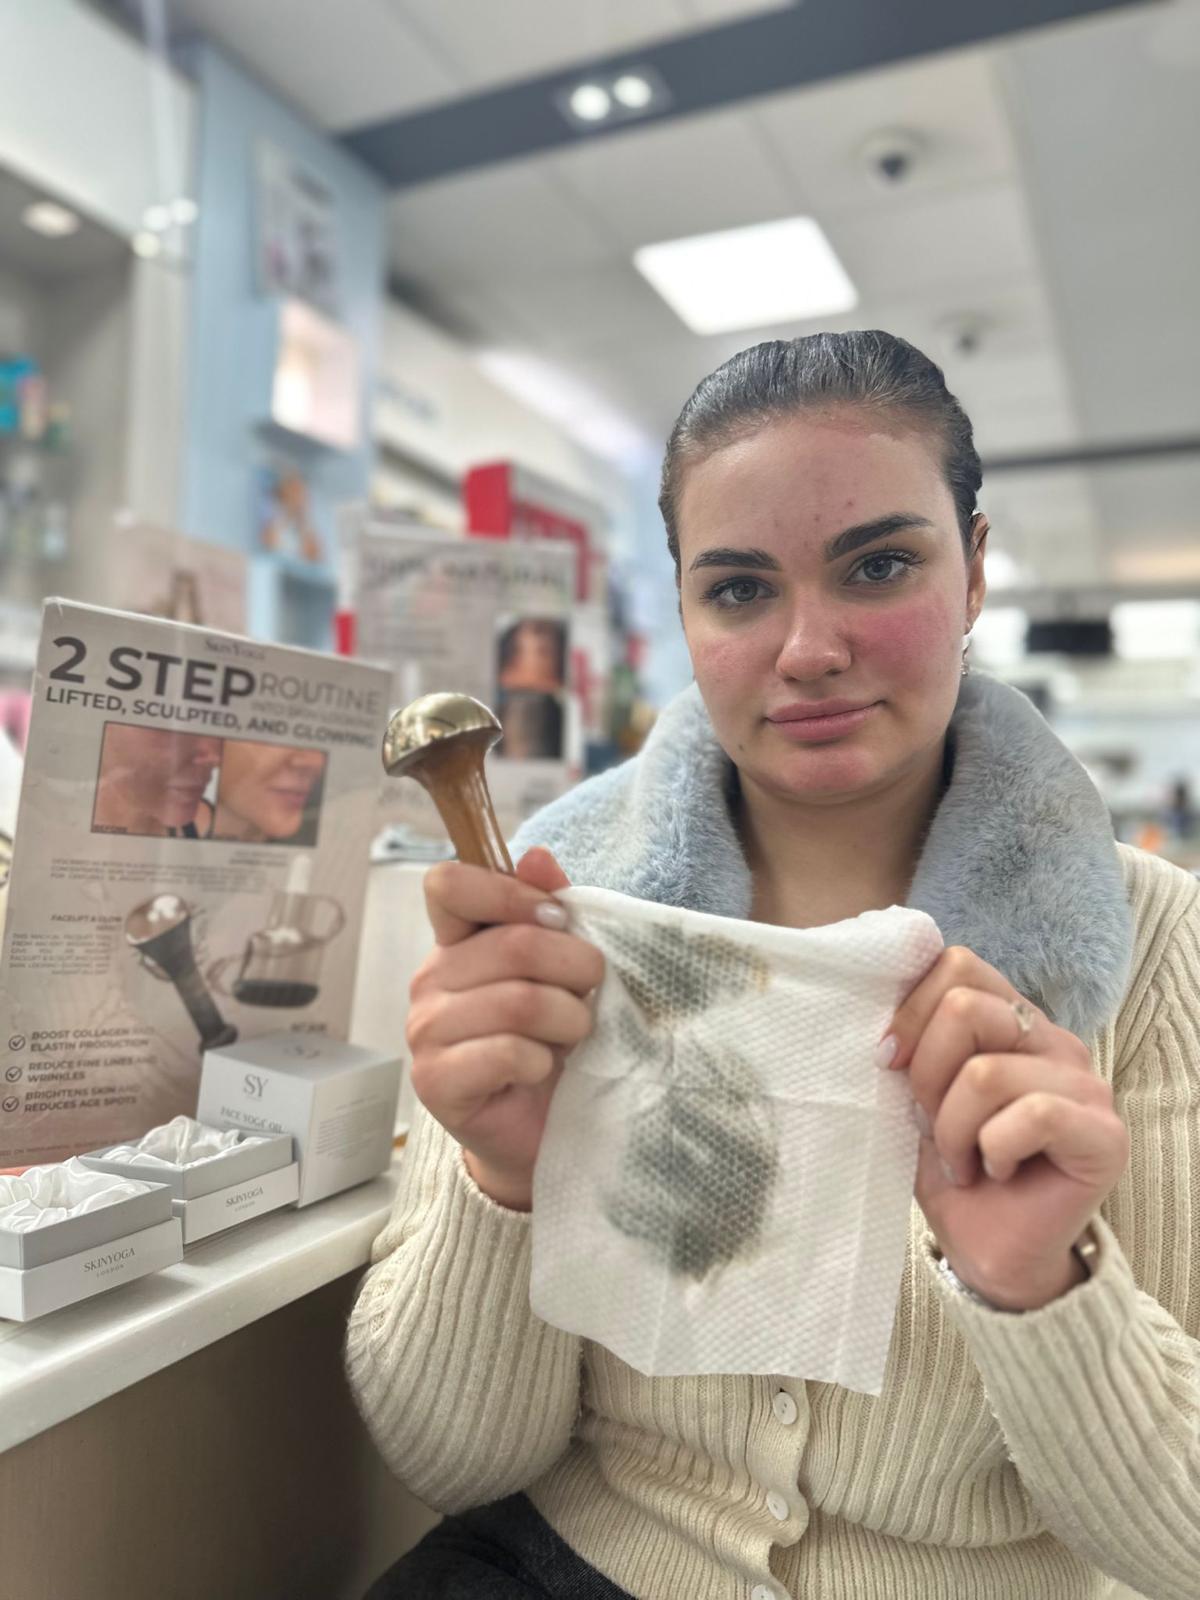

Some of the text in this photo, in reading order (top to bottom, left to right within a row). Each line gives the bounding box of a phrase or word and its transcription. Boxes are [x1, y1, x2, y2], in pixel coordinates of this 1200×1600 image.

[50, 636, 382, 715] 2 STEP ROUTINE
[46, 686, 376, 750] LIFTED, SCULPTED, AND GLOWING
[32, 1030, 70, 1041] BOOST
[73, 1028, 130, 1039] COLLAGEN
[31, 1039, 148, 1052] ELASTIN PRODUCTION
[29, 1060, 74, 1071] REDUCE
[77, 1059, 100, 1069] FINE
[104, 1057, 133, 1067] LINES
[27, 1071, 85, 1083] WRINKLES
[244, 1073, 269, 1097] SY
[26, 1088, 89, 1101] BRIGHTENS
[24, 1101, 77, 1113] REDUCES
[83, 1247, 136, 1273] SKINYOGA
